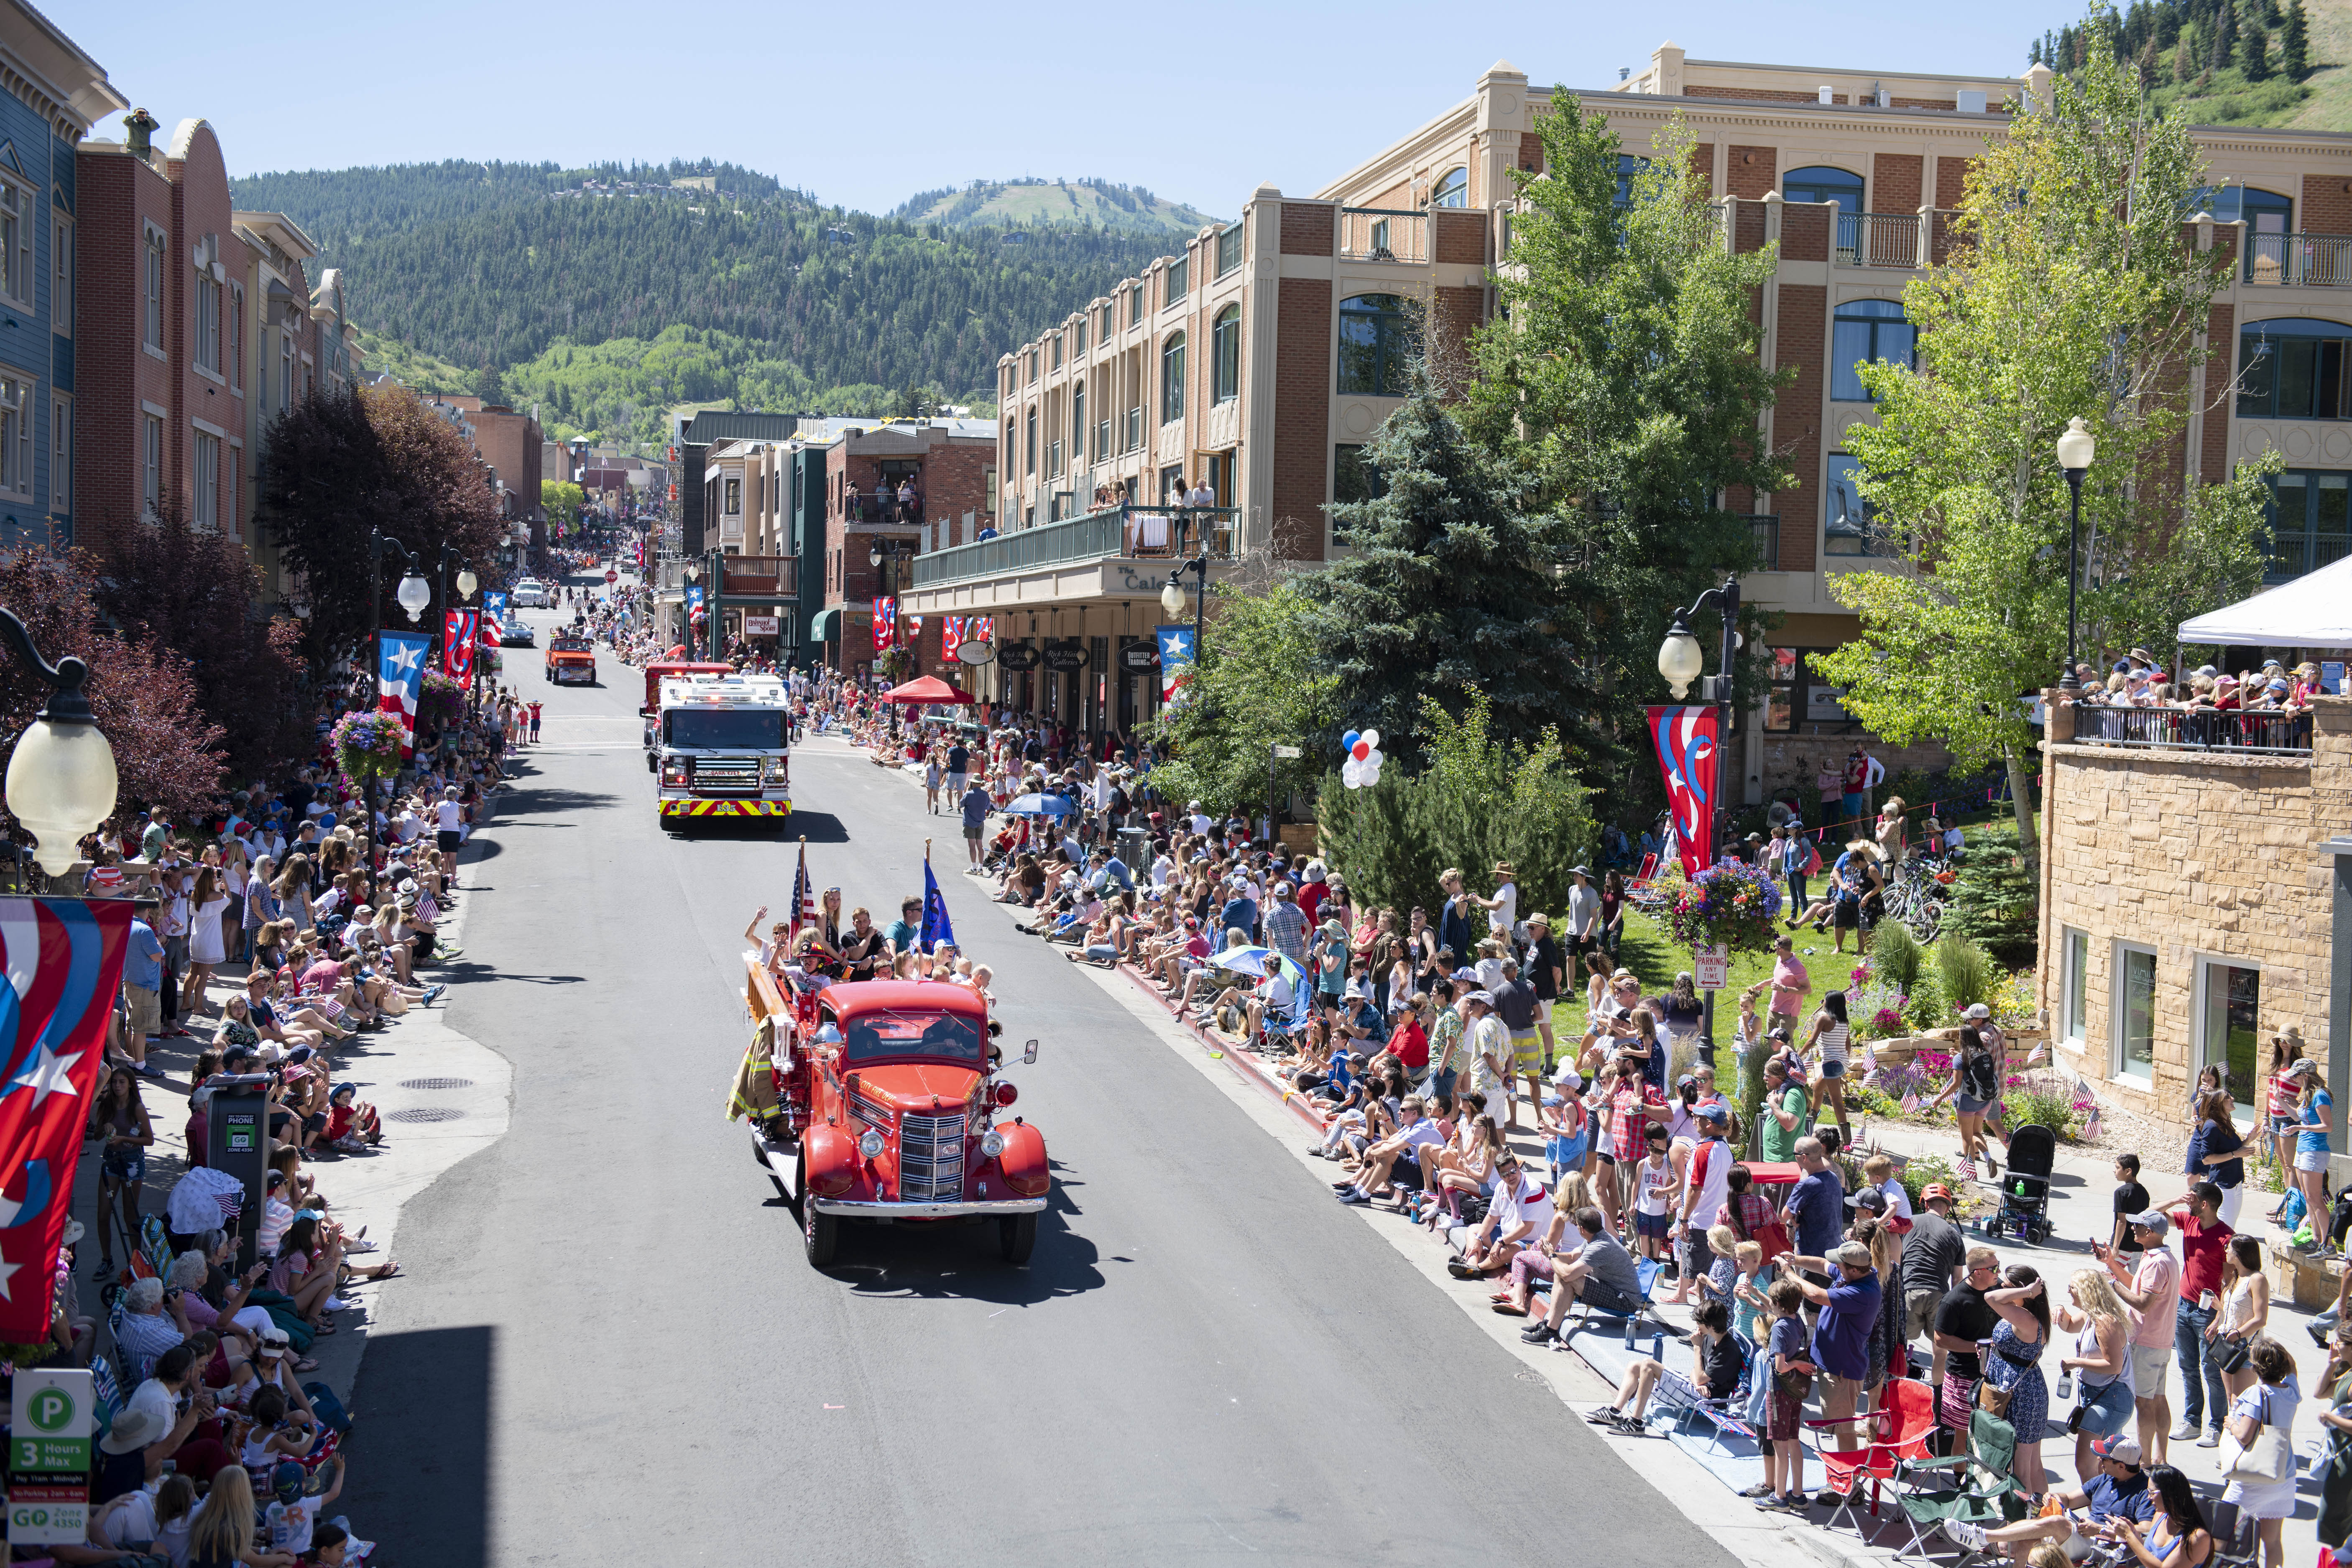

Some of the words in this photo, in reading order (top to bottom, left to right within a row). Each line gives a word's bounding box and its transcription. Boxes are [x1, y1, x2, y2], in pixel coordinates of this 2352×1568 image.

[963, 647, 986, 655] Grac
[1698, 957, 1724, 966] PARKING
[860, 1080, 873, 1092] CITY
[871, 1085, 883, 1098] FIRE
[944, 1144, 958, 1153] Mack
[1645, 1173, 1663, 1187] USA
[42, 1397, 63, 1424] P
[20, 1441, 38, 1467] 3
[45, 1443, 81, 1454] Hours
[45, 1456, 71, 1466] Max
[15, 1474, 27, 1484] Pay
[31, 1474, 48, 1483] 11am
[54, 1474, 83, 1484] Midnight
[23, 1490, 48, 1499] Parking
[54, 1507, 82, 1517] Zone
[53, 1519, 82, 1528] 4350
